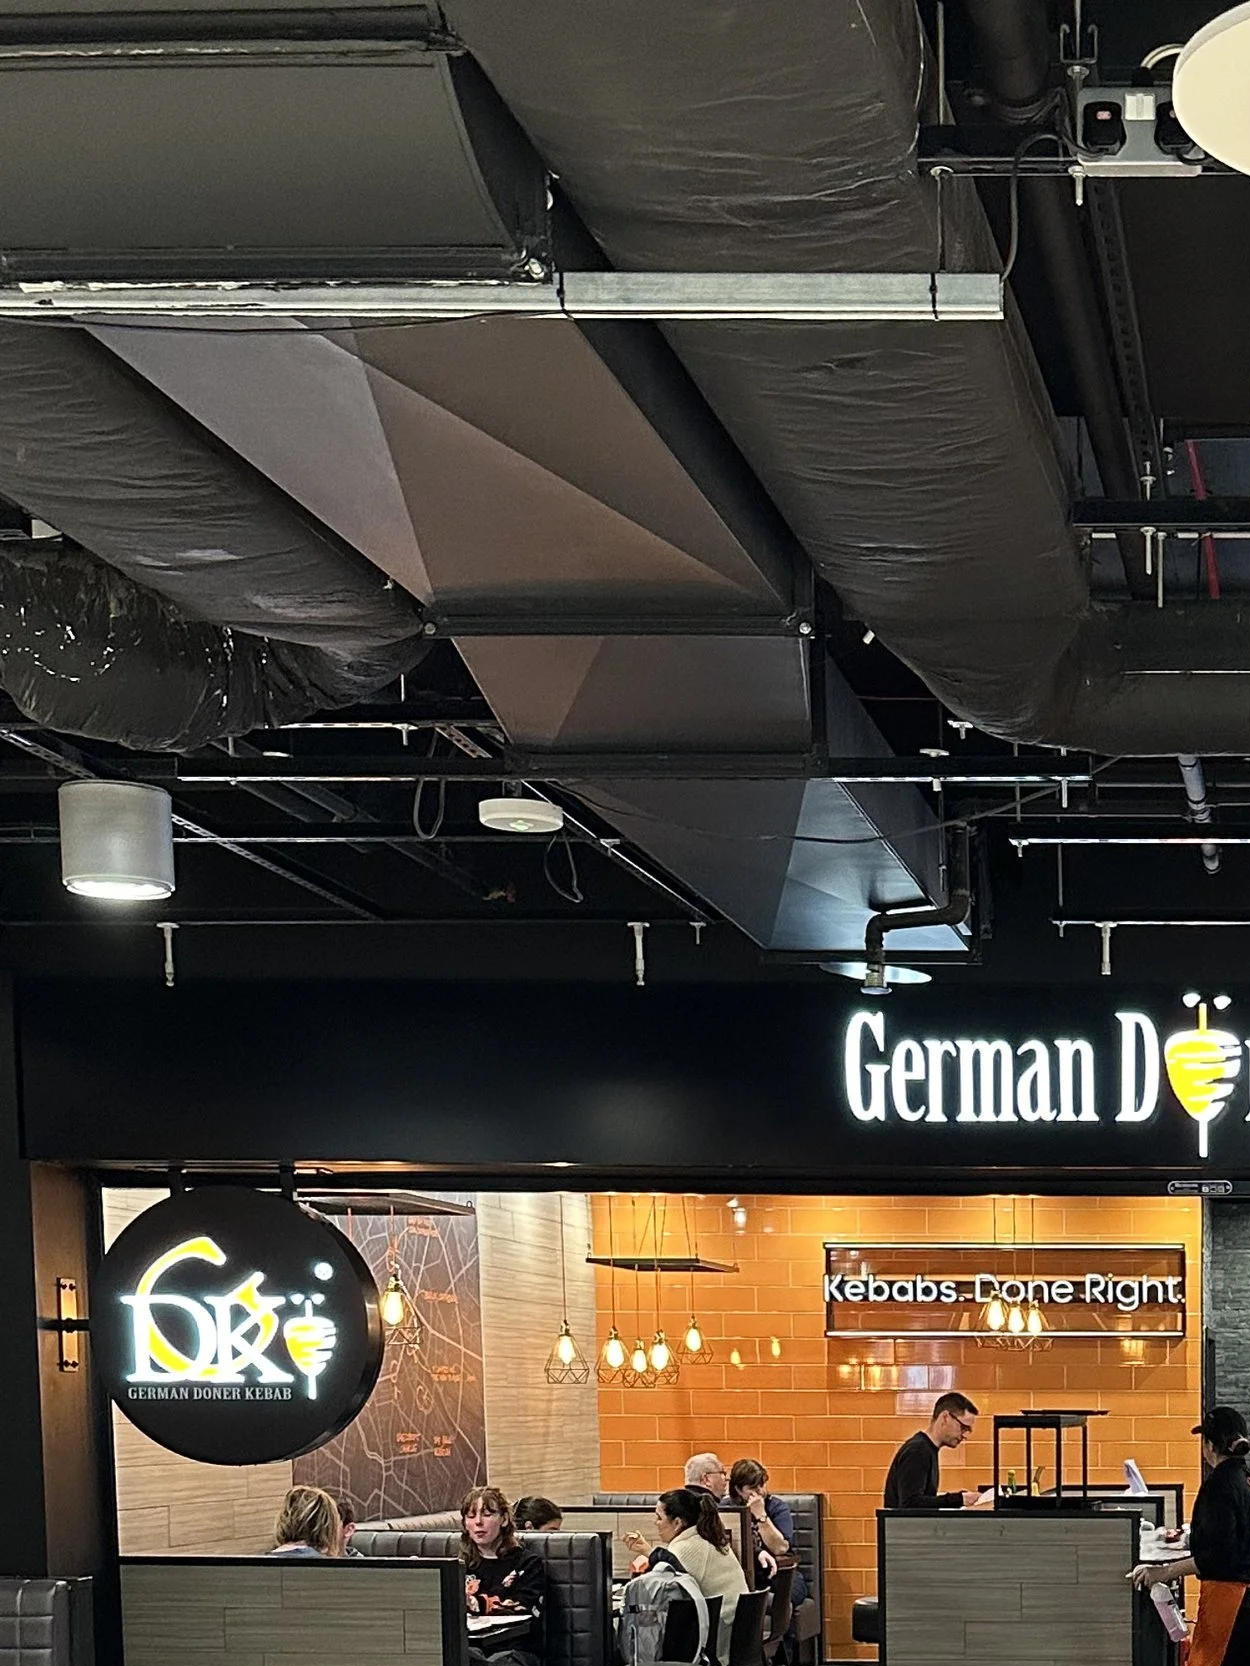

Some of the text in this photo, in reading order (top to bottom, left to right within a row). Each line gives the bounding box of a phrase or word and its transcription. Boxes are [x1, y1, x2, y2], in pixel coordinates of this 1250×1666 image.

[845, 1011, 1100, 1123] German
[823, 1273, 1187, 1312] Kebabs. Done Right.
[128, 1387, 292, 1400] GERMAN DONER KEBAB
